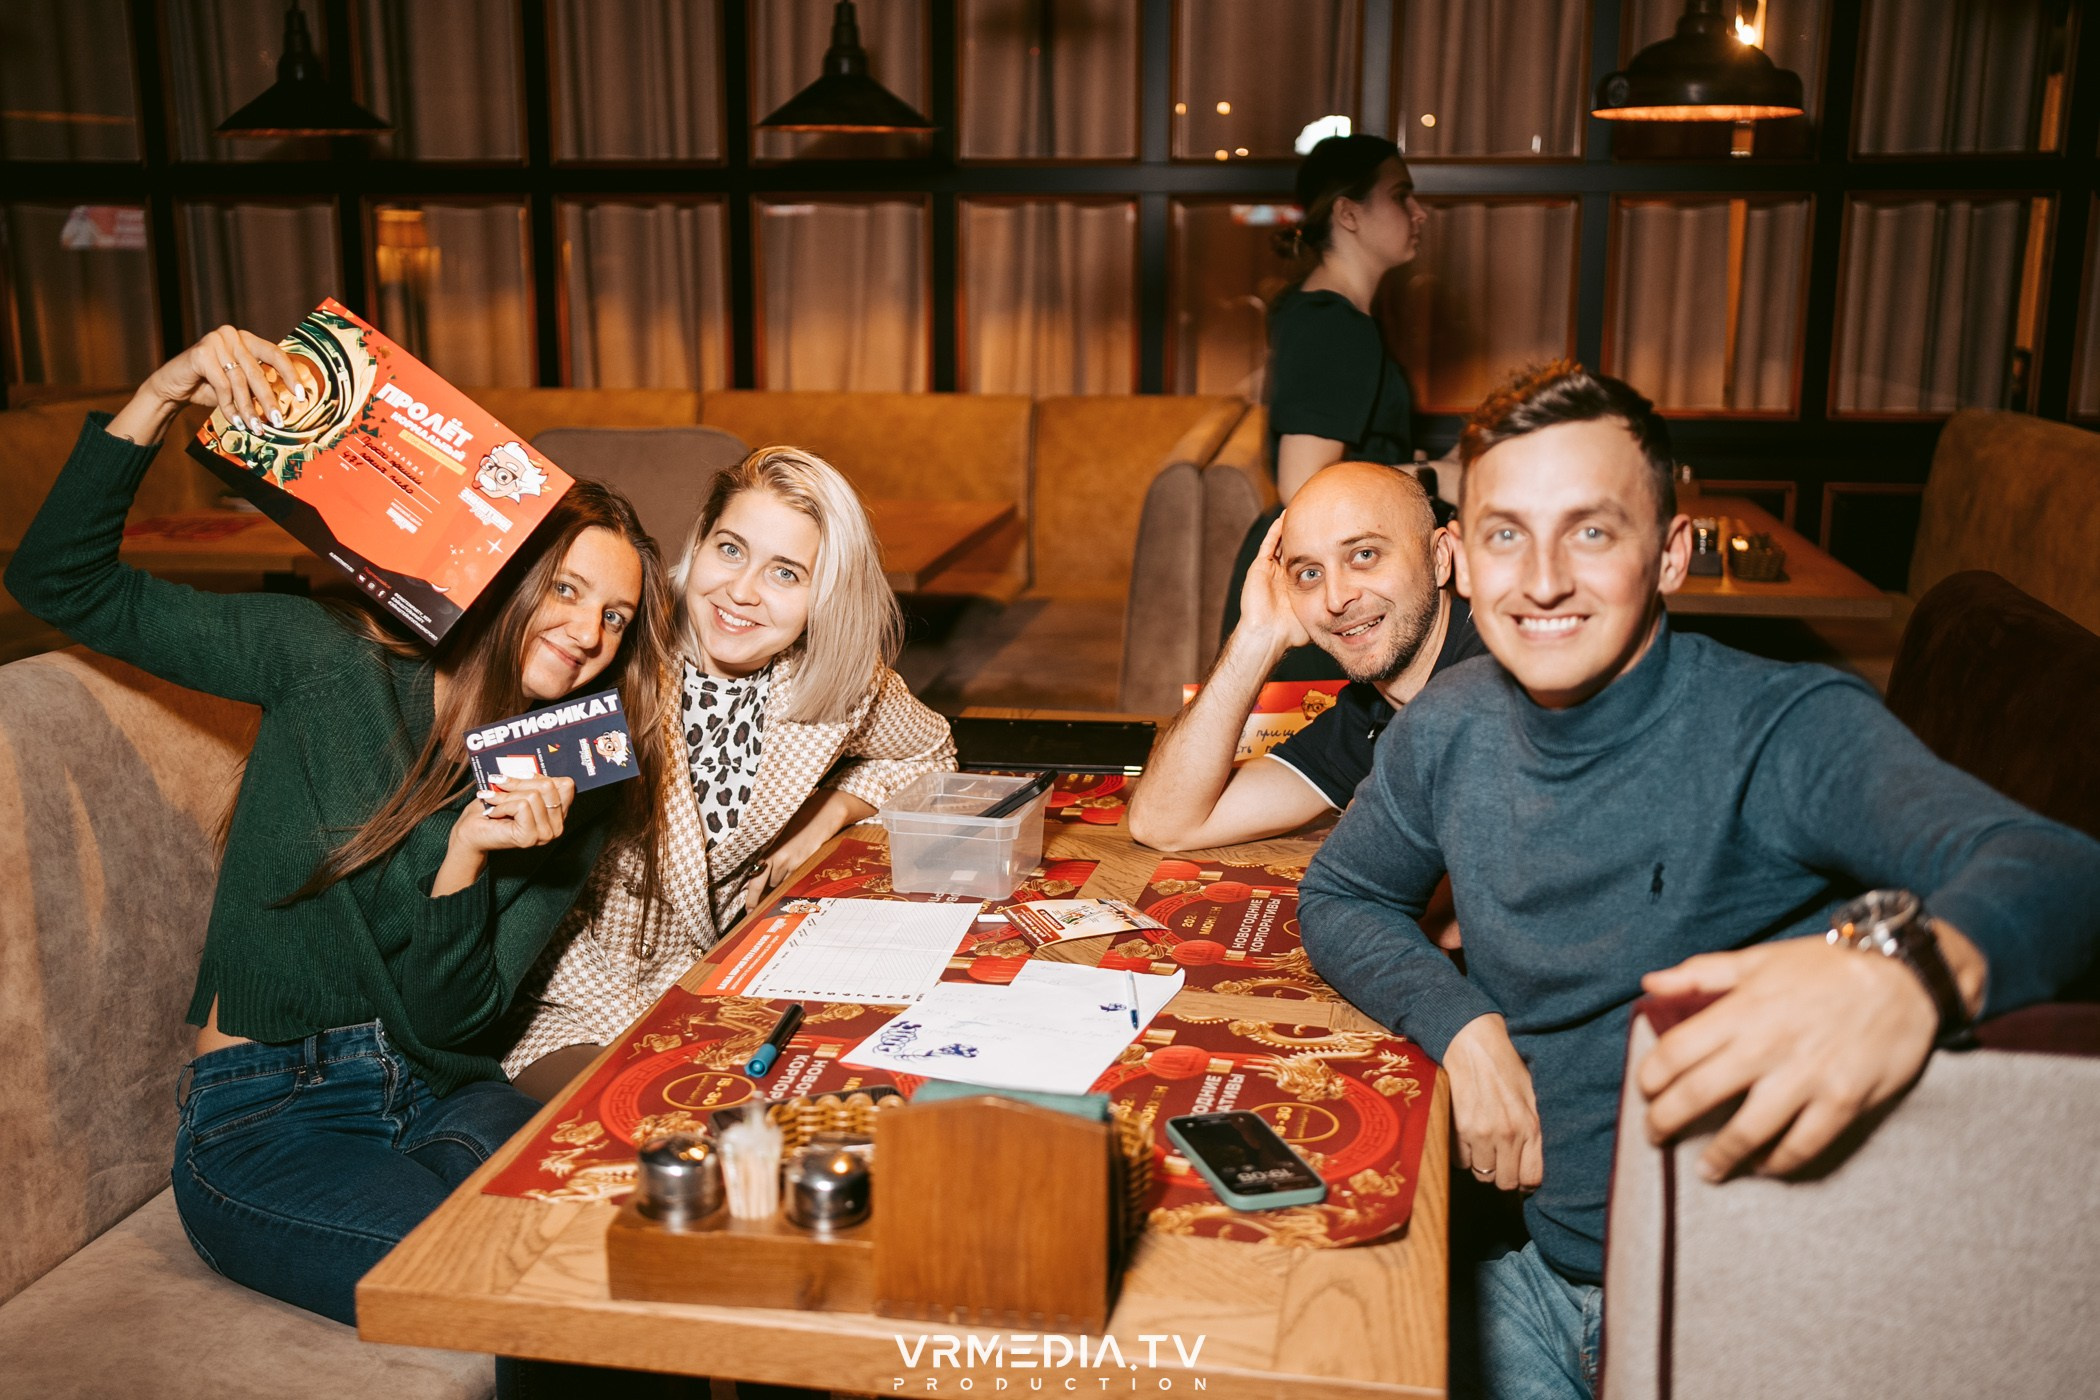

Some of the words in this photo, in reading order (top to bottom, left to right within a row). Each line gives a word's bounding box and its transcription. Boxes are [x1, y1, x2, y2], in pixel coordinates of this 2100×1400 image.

[376, 382, 474, 447] ПРОЛЁТ
[390, 411, 468, 463] НОРМАЛЬНЫЙ
[380, 441, 425, 476] КОМАНДА
[466, 694, 618, 751] СЕРТИФИКАТ
[1232, 899, 1264, 949] НОВОГОДНИЕ
[1249, 898, 1282, 952] КОРПОРАТИВЫ
[765, 1054, 810, 1102] КОРПОР
[793, 1060, 828, 1096] НОВОГ
[1191, 1075, 1222, 1115] ОДНИЕ
[1217, 1074, 1246, 1112] АТИВЫ
